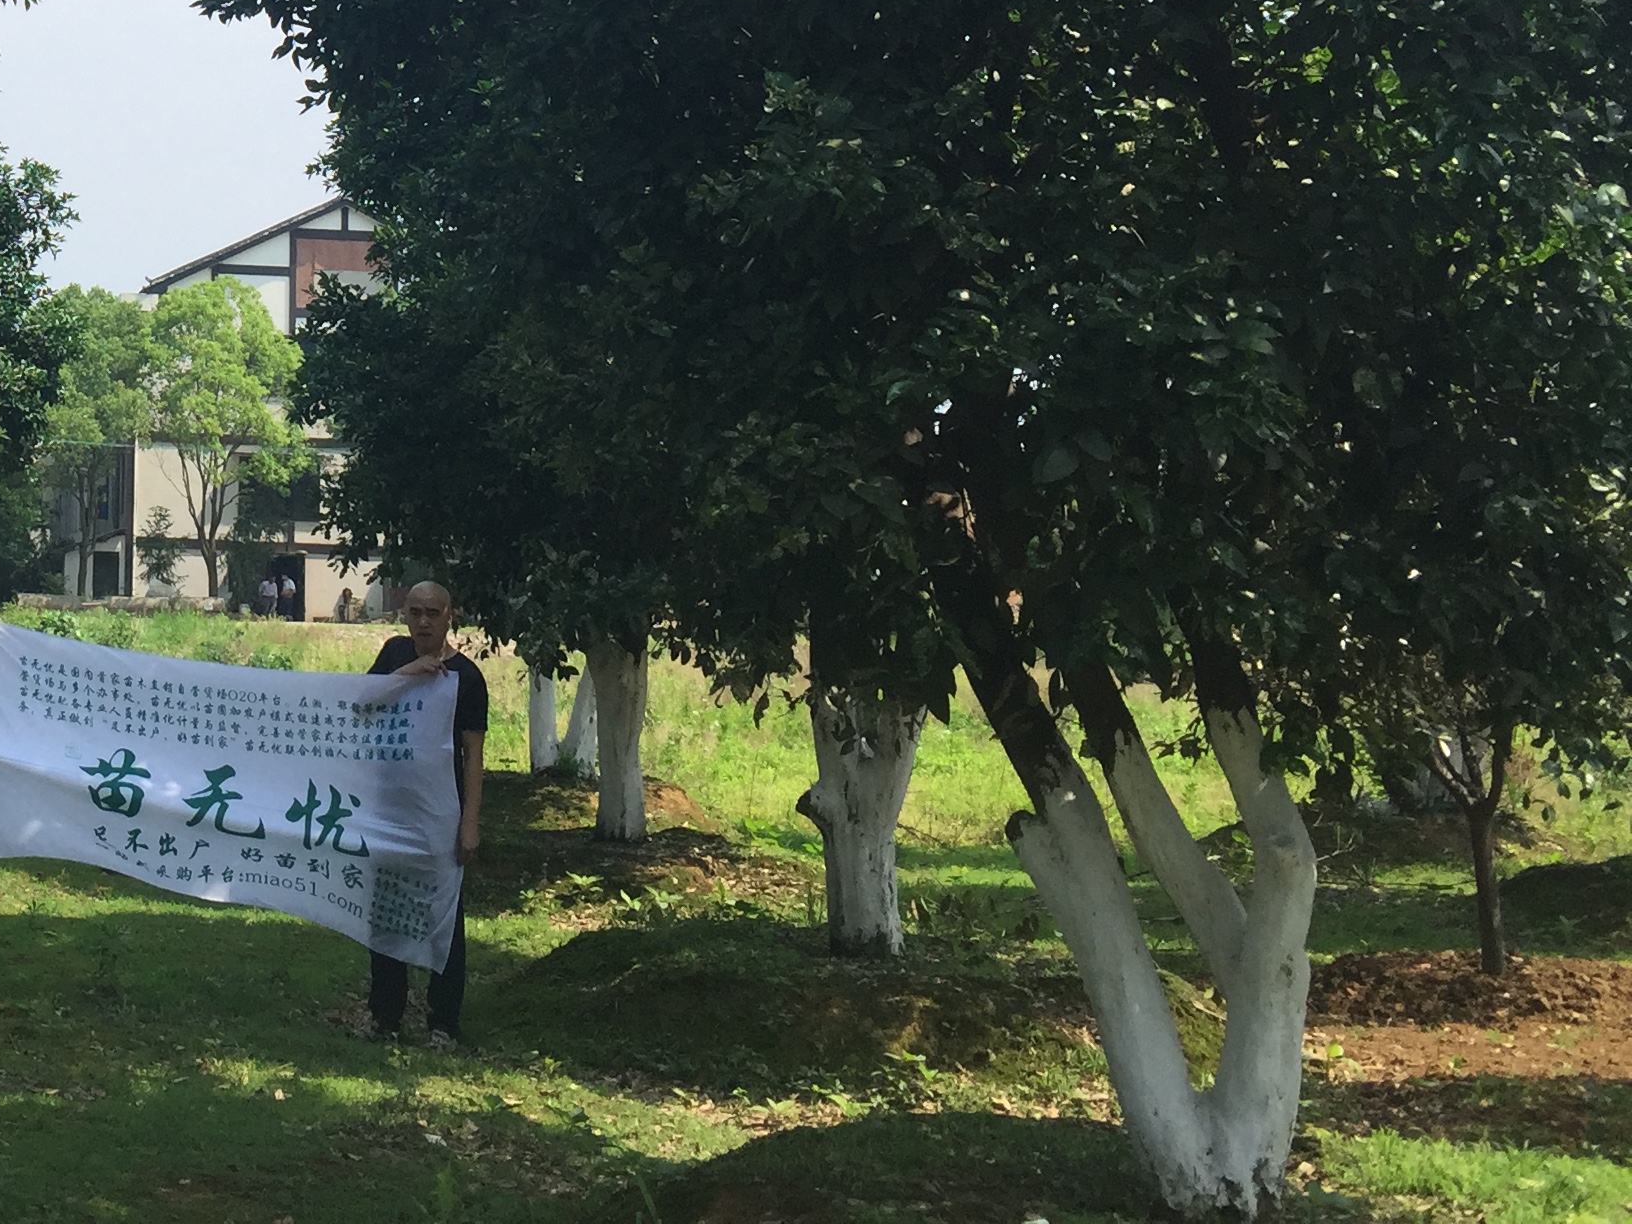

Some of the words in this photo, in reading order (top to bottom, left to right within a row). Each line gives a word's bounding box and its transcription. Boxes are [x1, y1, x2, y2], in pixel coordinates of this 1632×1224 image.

[79, 747, 370, 857] 苗无忧
[241, 846, 364, 890] 好苗到家
